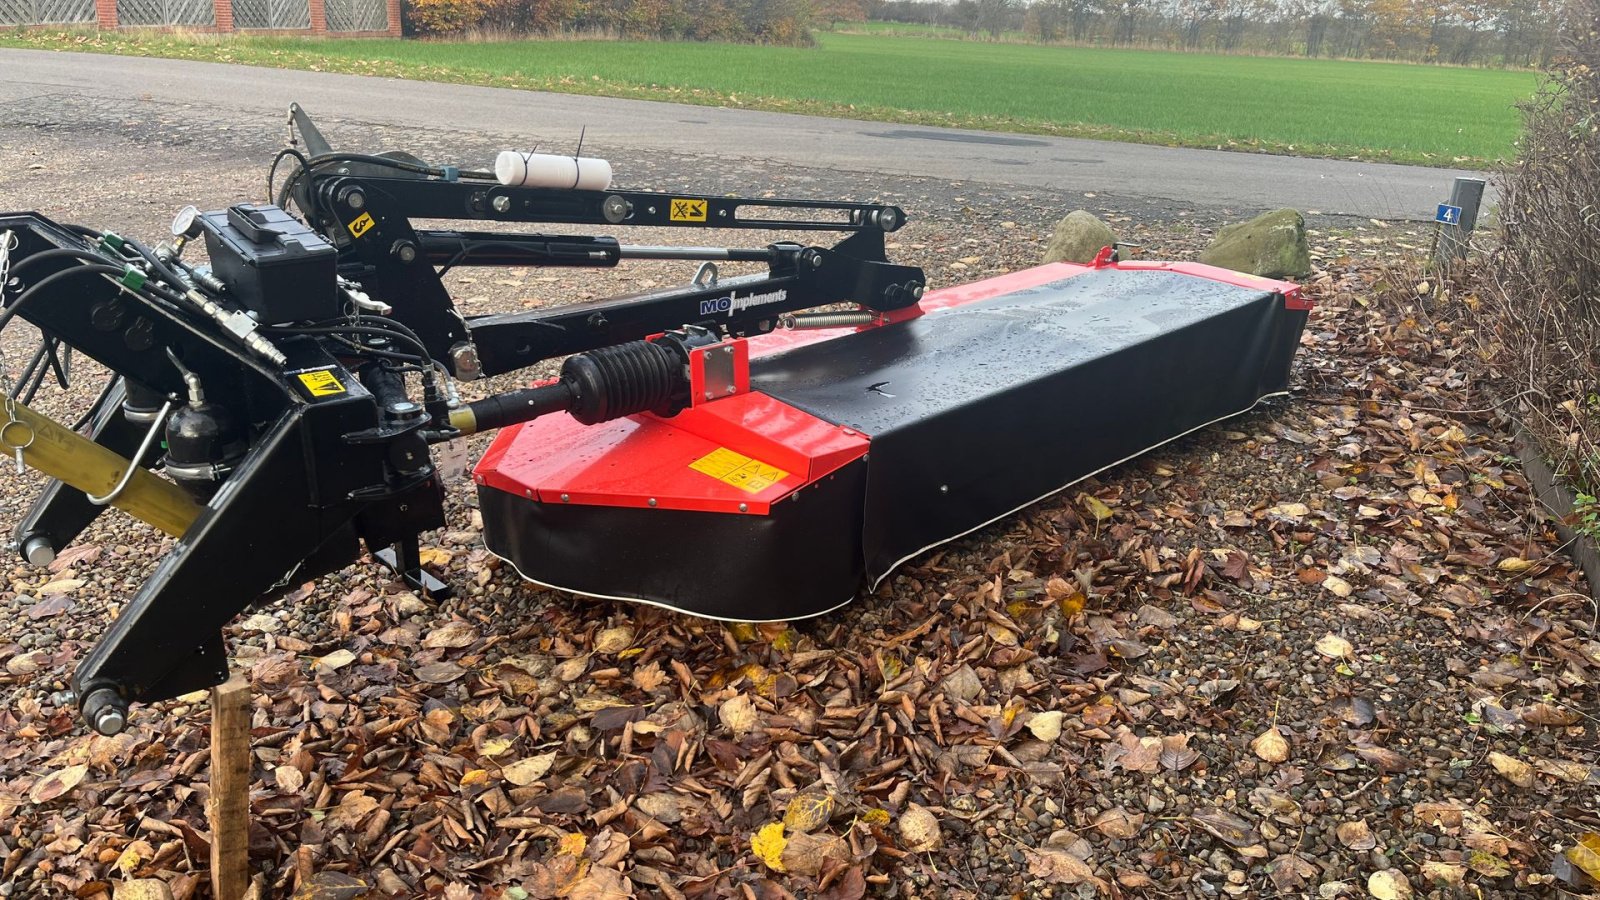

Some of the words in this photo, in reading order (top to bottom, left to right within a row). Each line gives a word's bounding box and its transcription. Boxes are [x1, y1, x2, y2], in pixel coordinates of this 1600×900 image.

[1443, 208, 1453, 222] 4
[700, 297, 732, 315] MO
[728, 289, 787, 317] Implements
